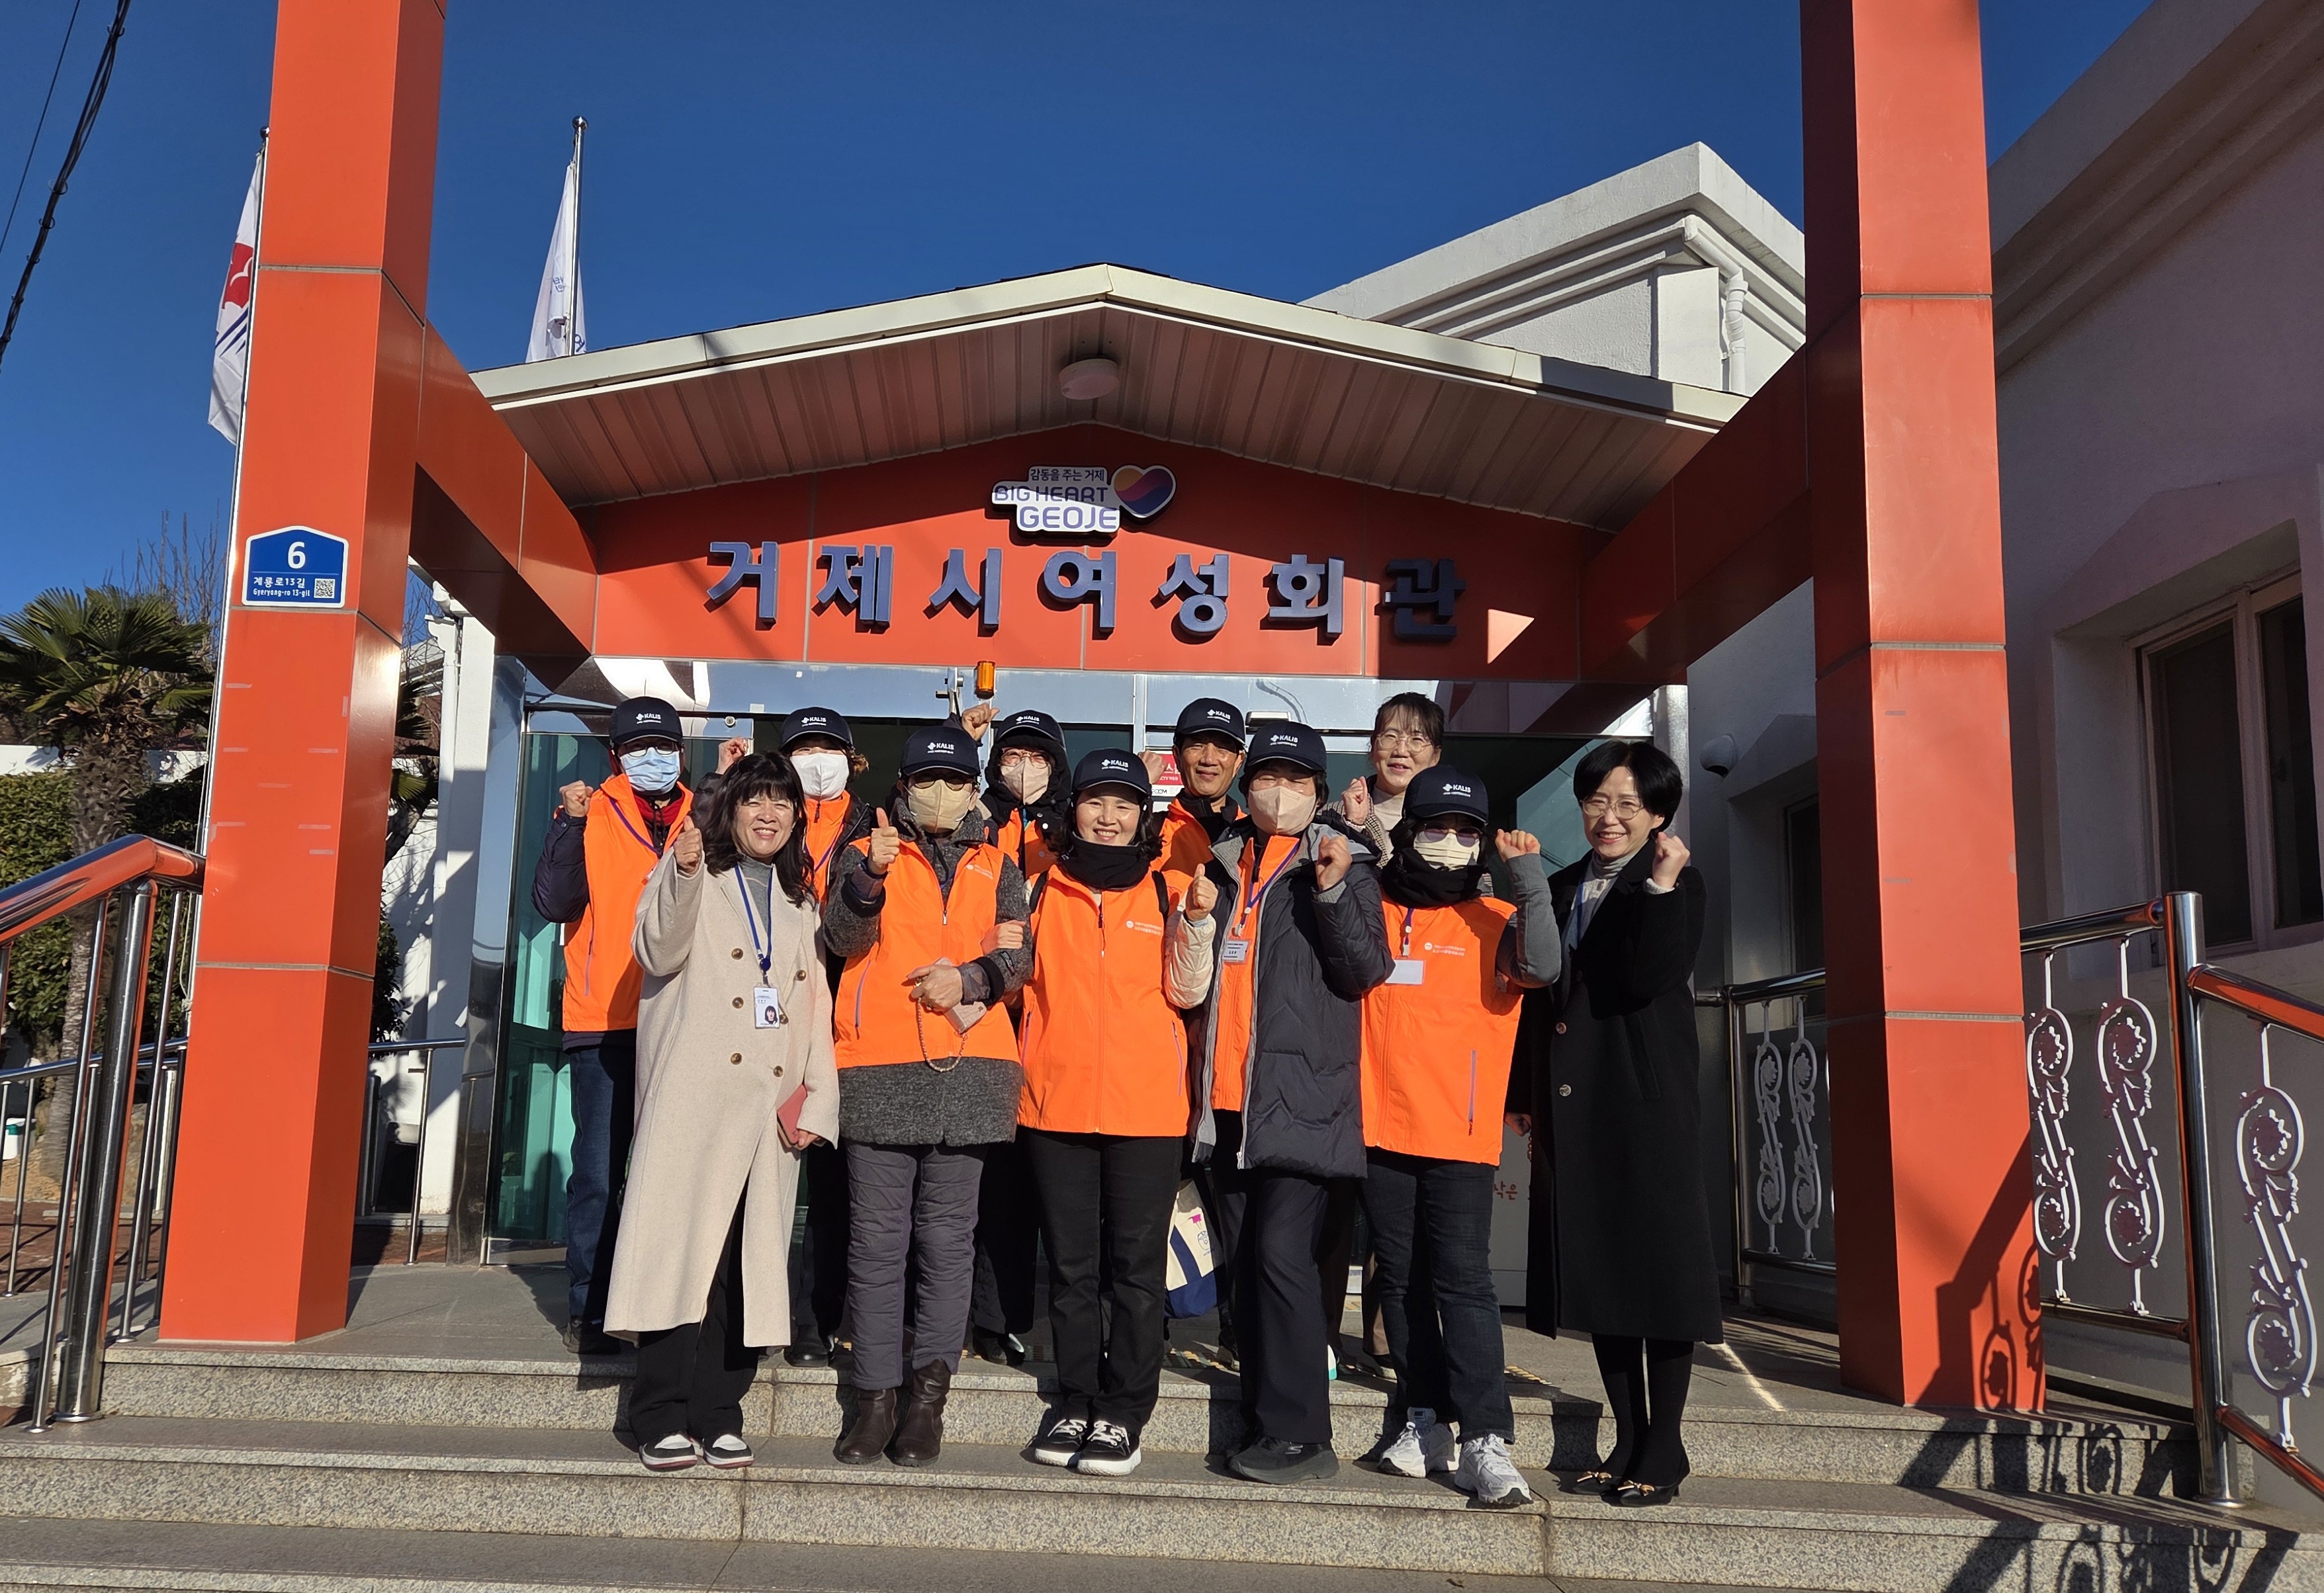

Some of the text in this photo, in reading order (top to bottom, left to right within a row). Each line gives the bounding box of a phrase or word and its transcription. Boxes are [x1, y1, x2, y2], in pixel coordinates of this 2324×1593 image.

[1030, 469, 1104, 482] 감동을 주는 거제
[994, 485, 1108, 503] BIG HEART
[1020, 506, 1117, 529] GEOJE
[288, 541, 306, 569] 6
